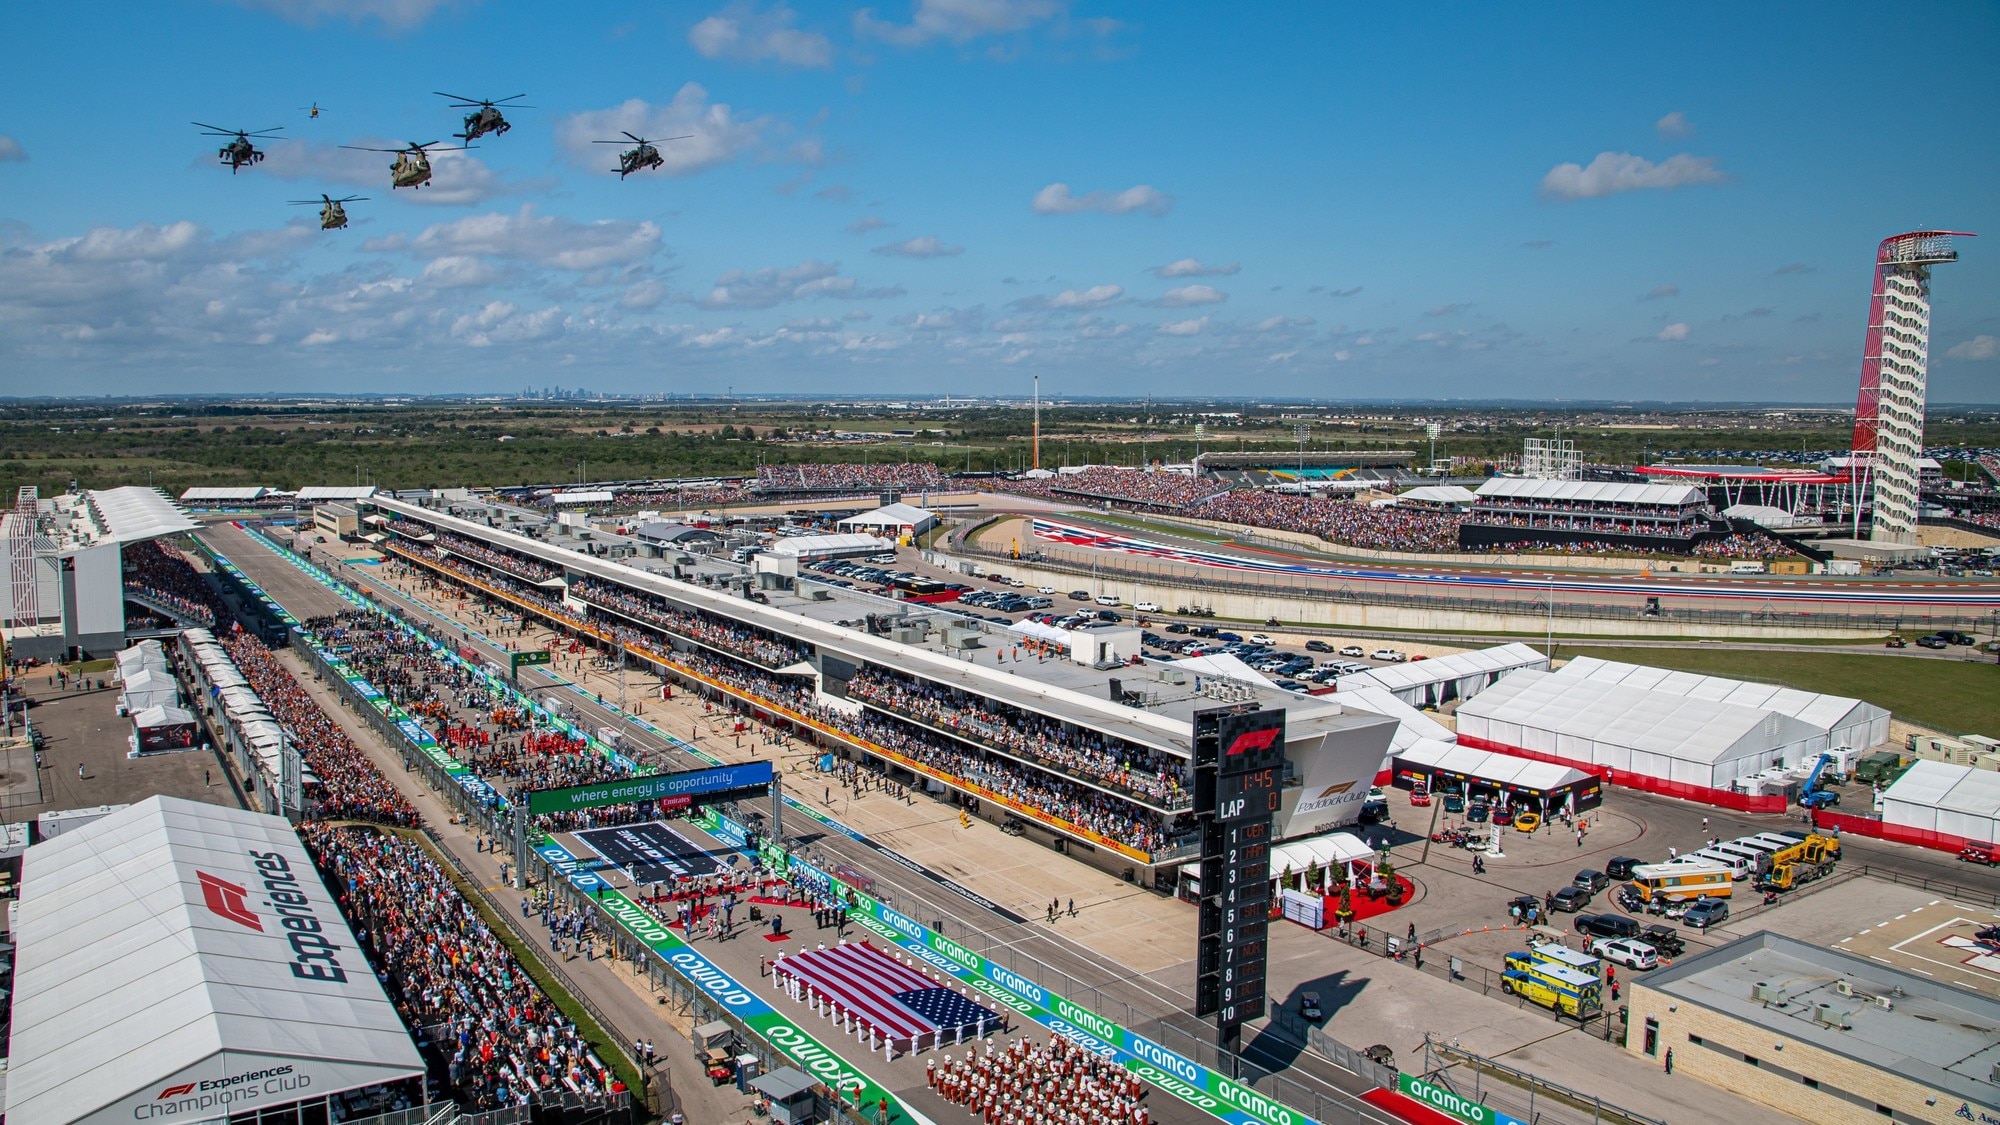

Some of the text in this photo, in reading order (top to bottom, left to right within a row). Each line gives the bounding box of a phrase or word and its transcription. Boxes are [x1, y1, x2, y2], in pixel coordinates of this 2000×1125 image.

[838, 731, 850, 740] DHL
[858, 740, 871, 749] DHL
[1226, 728, 1280, 756] F1
[903, 758, 918, 768] DHL
[927, 768, 942, 777] DHL
[570, 772, 734, 804] where energy is opportunity
[952, 777, 968, 788] DHL
[1098, 779, 1114, 788] F1
[1244, 770, 1273, 790] 1:45
[1316, 780, 1358, 799] F1
[663, 796, 690, 806] Emirates
[978, 788, 995, 799] DHL
[1131, 791, 1148, 800] F1
[1298, 790, 1366, 812] Paddock Club
[1006, 800, 1024, 810] DHL
[1220, 799, 1245, 819] LAP
[1036, 812, 1054, 823] DHL
[724, 820, 747, 841] aramc
[1067, 824, 1087, 836] DHL
[1230, 829, 1236, 843] 1
[1100, 837, 1121, 850] DHL
[1229, 844, 1264, 864] 2 HAM
[544, 849, 599, 885] armco
[578, 860, 602, 869] aramco
[1228, 864, 1262, 884] 3 PER
[195, 870, 265, 933] F1
[836, 884, 872, 912] armco
[1228, 889, 1236, 902] 4
[248, 850, 348, 984] Experiences
[602, 898, 668, 942] aramco
[850, 912, 898, 938] aramco
[883, 909, 922, 939] aramco
[1228, 909, 1234, 923] 5
[1227, 928, 1234, 942] 6
[908, 944, 961, 973] aramco
[935, 936, 978, 969] aramco
[1226, 942, 1260, 962] 7 NOR
[671, 953, 752, 1006] aramco
[992, 967, 1042, 1002] aramco
[1226, 968, 1232, 982] 8
[972, 980, 1032, 1012] aramco
[1225, 988, 1232, 1001] 9
[1546, 983, 1562, 994] EMS
[1058, 1001, 1114, 1040] aramco
[1222, 1006, 1234, 1021] 10
[1048, 1020, 1118, 1056] aramco
[766, 1026, 867, 1092] aramco
[1134, 1039, 1197, 1081] aramco
[156, 1064, 293, 1100] F1 Experiences
[1138, 1067, 1218, 1108] aramco
[134, 1074, 311, 1120] Champions Club
[1218, 1081, 1292, 1125] aramco
[1410, 1081, 1484, 1121] aramco
[1978, 1112, 2000, 1125] Asc
